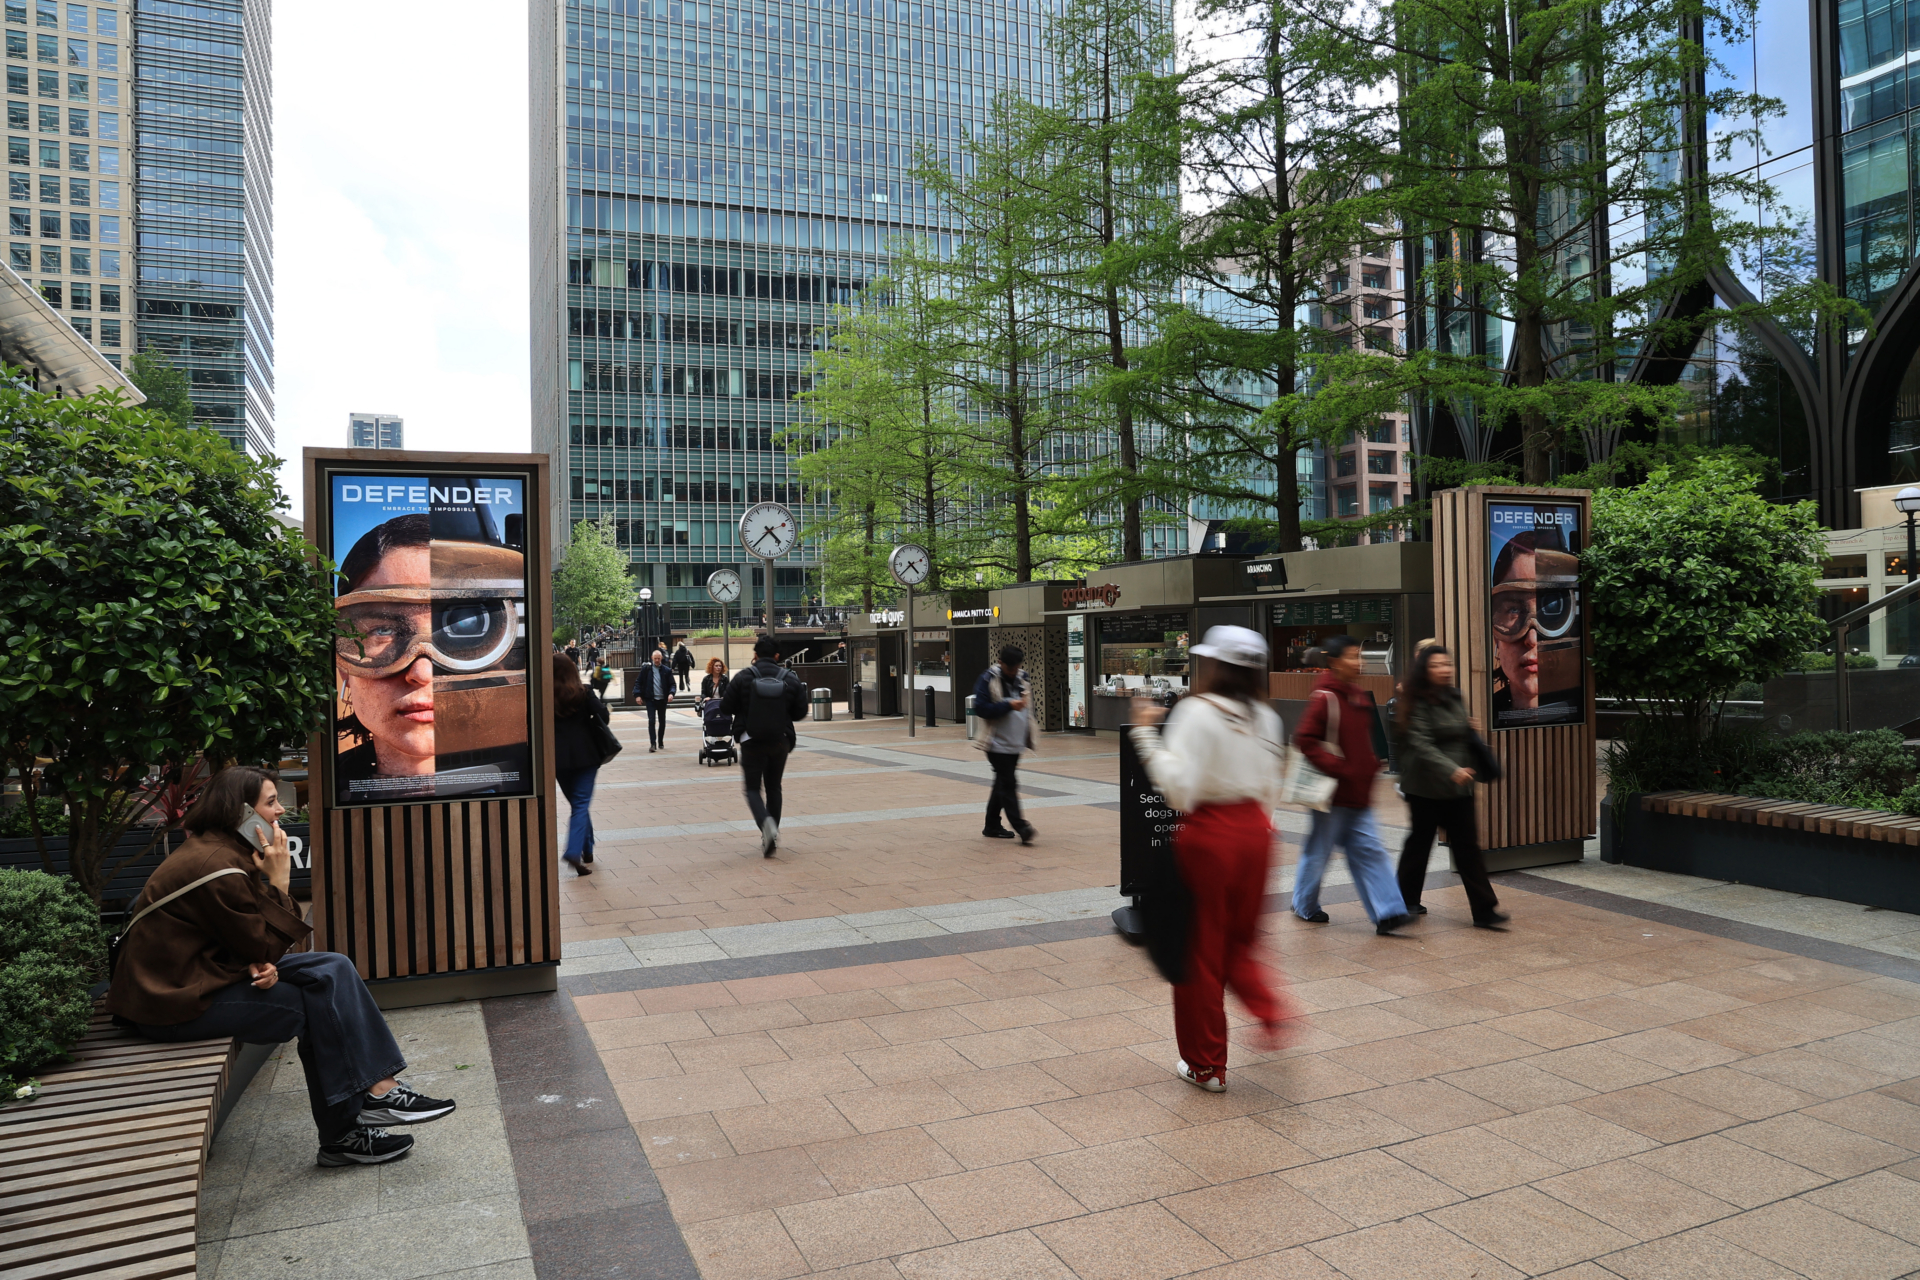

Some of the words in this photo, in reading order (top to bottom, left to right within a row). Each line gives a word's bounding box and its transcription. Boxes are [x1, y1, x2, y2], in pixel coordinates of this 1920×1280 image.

[342, 484, 513, 505] DEFENDER
[1494, 511, 1573, 525] DEFENDER
[1246, 563, 1273, 574] ARANCINO
[952, 609, 970, 619] JAMAICA
[970, 608, 984, 618] PATTY
[984, 608, 993, 617] CO.
[1139, 793, 1167, 804] Secu
[1144, 807, 1173, 819] dogs
[1154, 823, 1188, 834] opera
[1151, 836, 1162, 847] in
